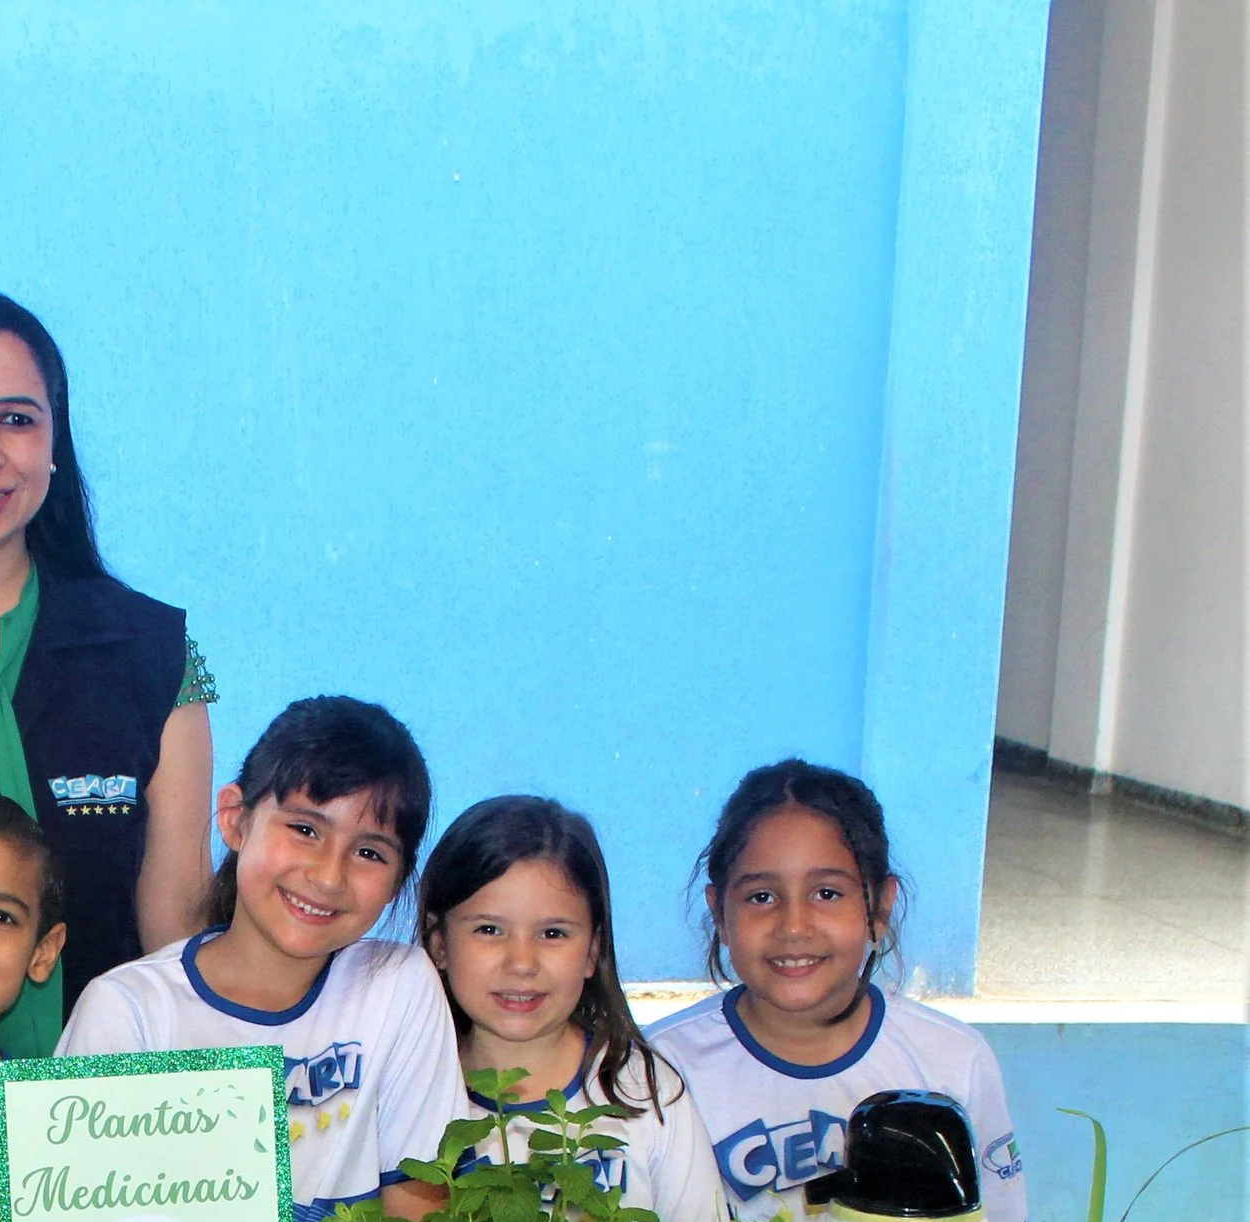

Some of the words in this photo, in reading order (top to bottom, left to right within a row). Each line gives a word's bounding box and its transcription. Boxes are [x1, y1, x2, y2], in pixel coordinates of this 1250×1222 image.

[49, 775, 137, 799] CEART
[285, 1042, 363, 1105] ART
[46, 1095, 220, 1145] Plantas
[714, 1110, 848, 1200] CEA
[14, 1165, 260, 1217] Medicinais
